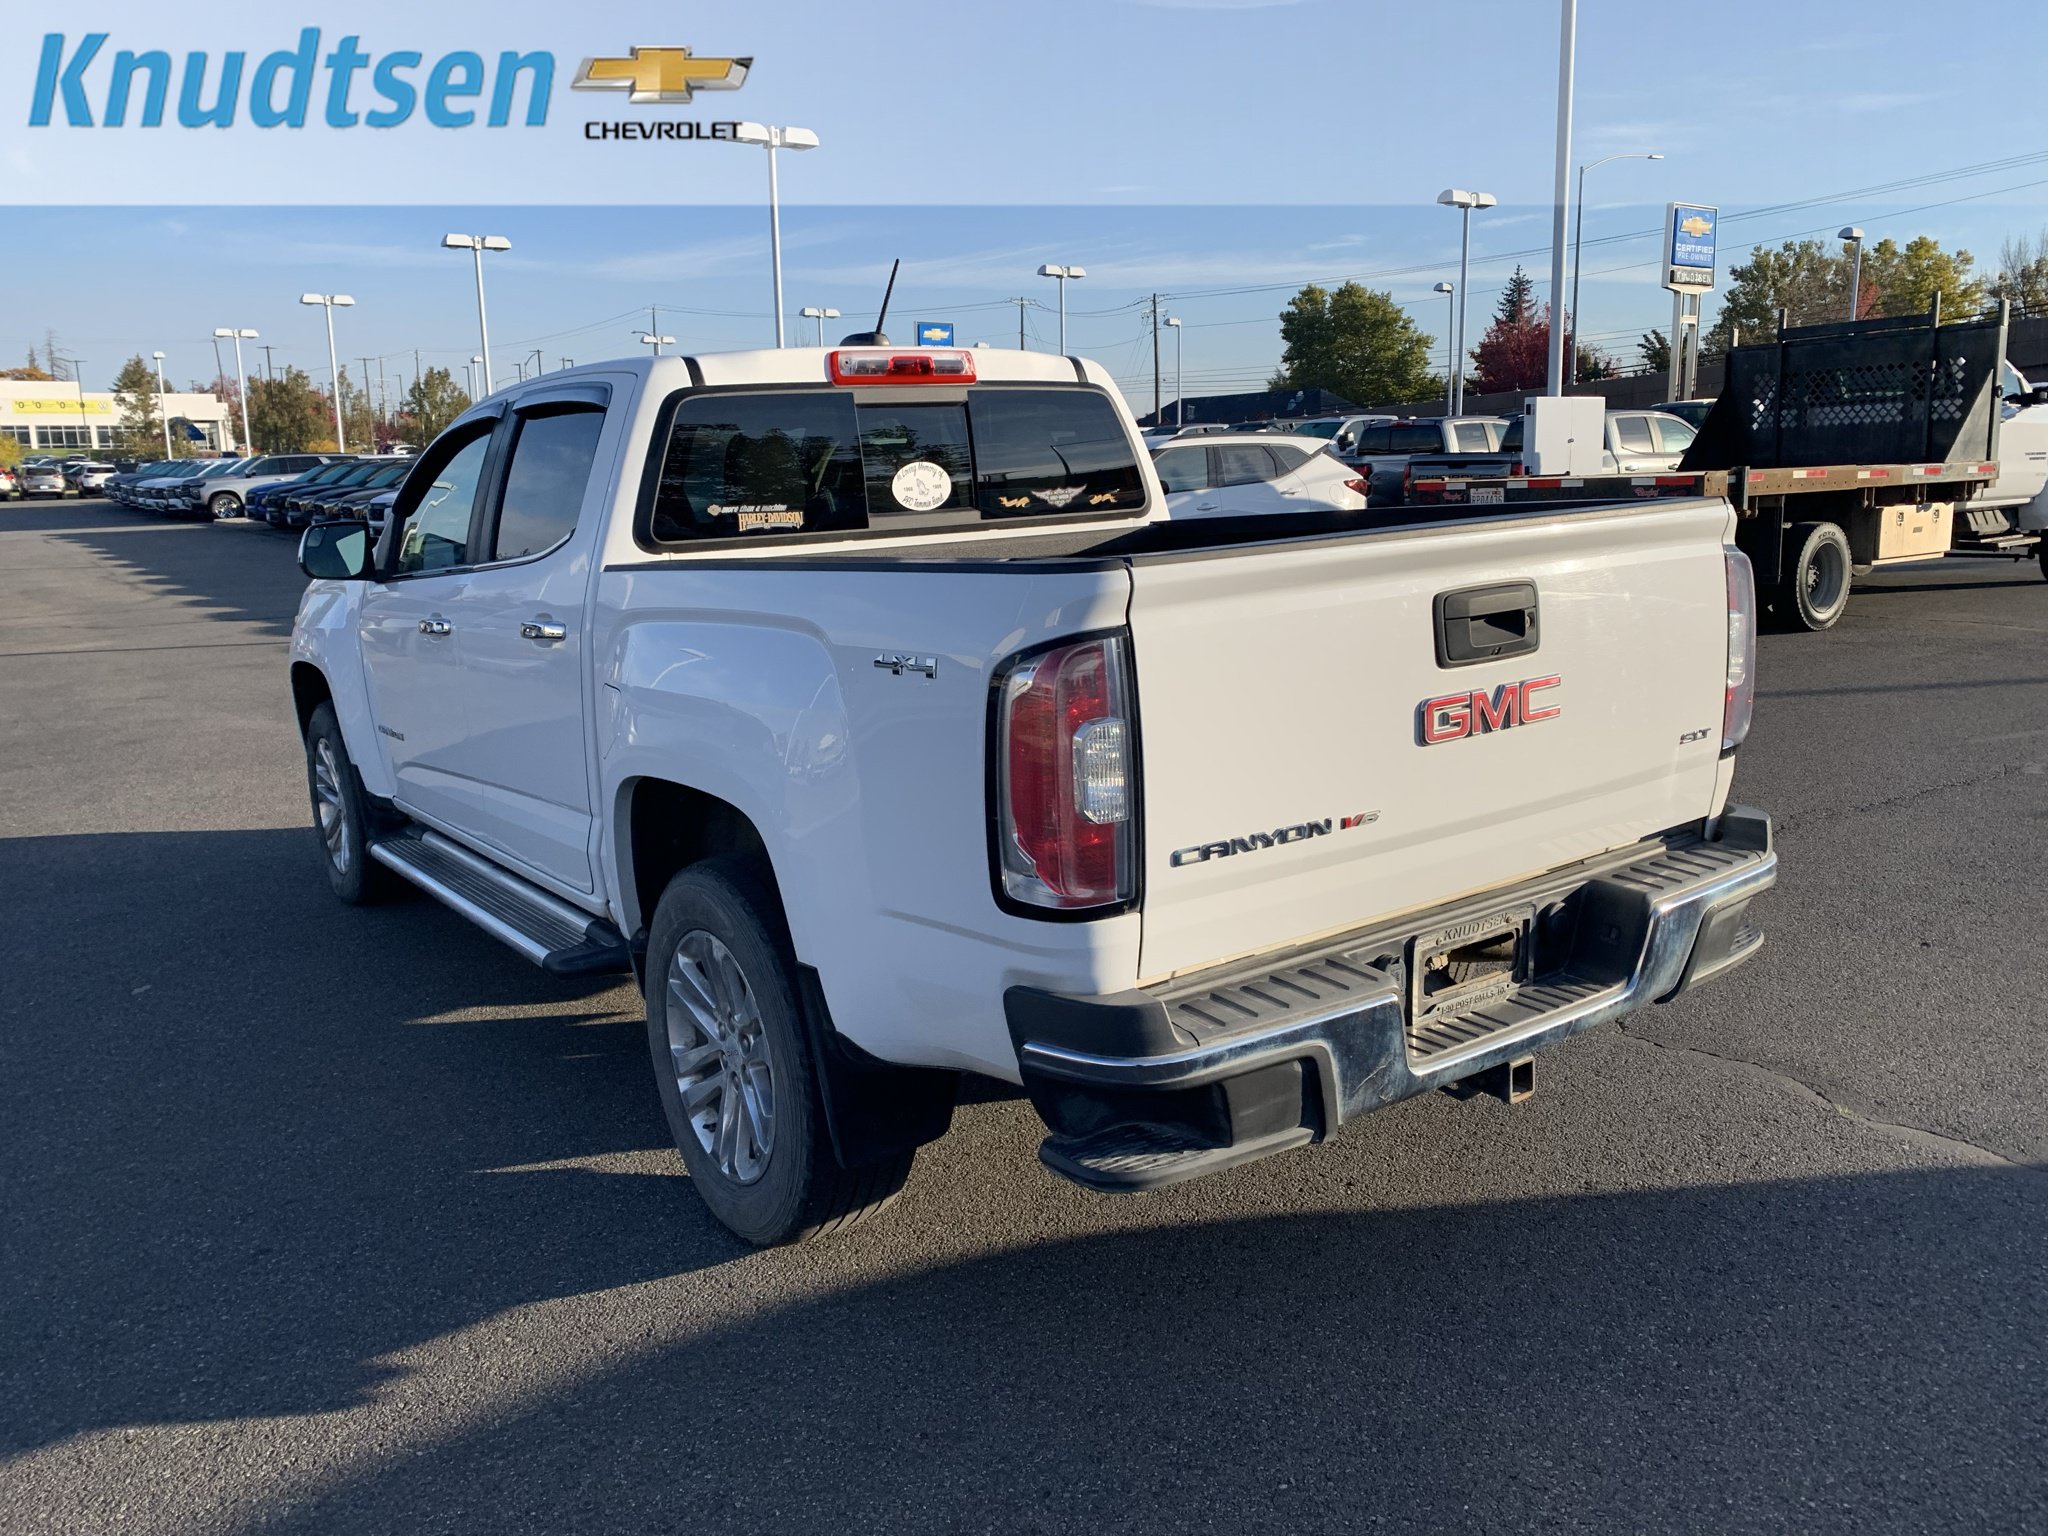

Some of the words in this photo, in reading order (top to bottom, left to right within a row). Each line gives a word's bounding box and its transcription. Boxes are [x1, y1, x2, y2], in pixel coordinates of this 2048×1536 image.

[1676, 243, 1714, 254] CERTIFIED
[918, 462, 937, 477] Memory
[761, 503, 787, 512] machine
[738, 511, 804, 531] HARLEY-DAVIDSON
[1414, 672, 1562, 747] GMC
[1680, 728, 1711, 745] SLT
[1170, 817, 1332, 868] CANYON
[1340, 809, 1381, 830] V6
[1455, 997, 1473, 1010] POST
